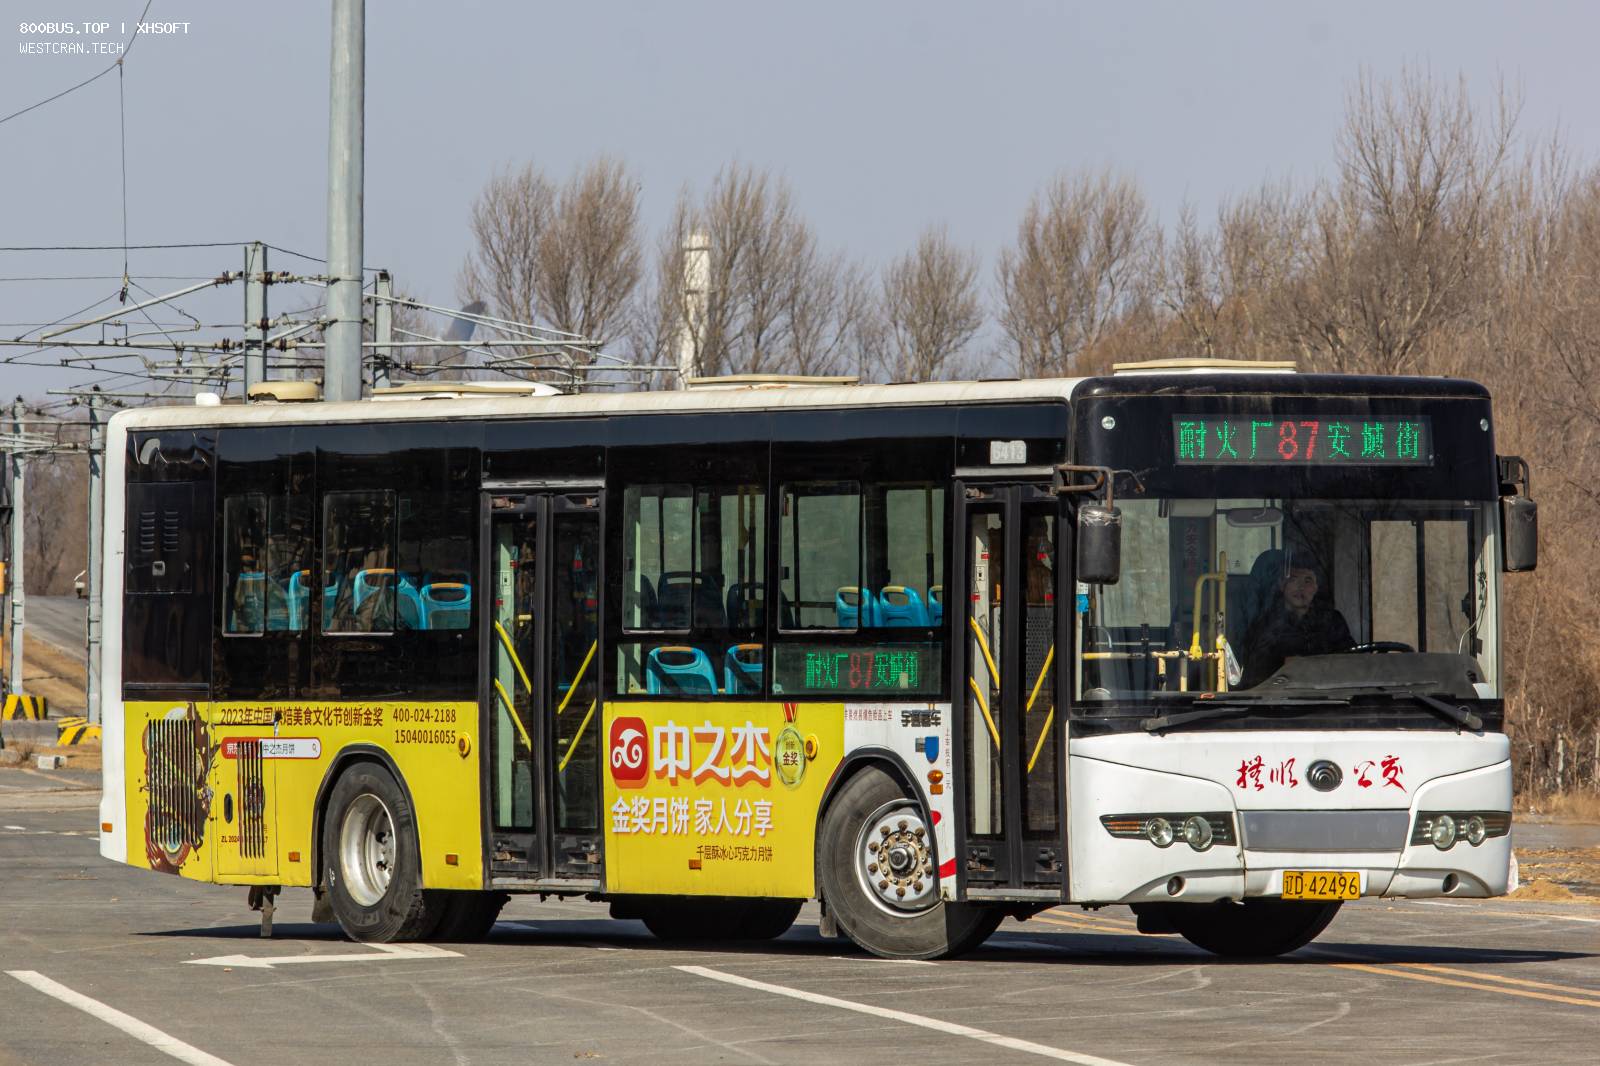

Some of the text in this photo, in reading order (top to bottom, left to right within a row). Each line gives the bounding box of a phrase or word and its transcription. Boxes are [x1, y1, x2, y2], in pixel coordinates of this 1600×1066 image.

[1179, 420, 1273, 460] 耐火厂
[1278, 420, 1319, 460] 87
[393, 708, 457, 723] 400-024-2188
[395, 729, 456, 744] 15040016055
[652, 720, 770, 780] 中之杰
[782, 751, 799, 767] 金奖
[611, 796, 775, 837] 金奖月饼 家人分享
